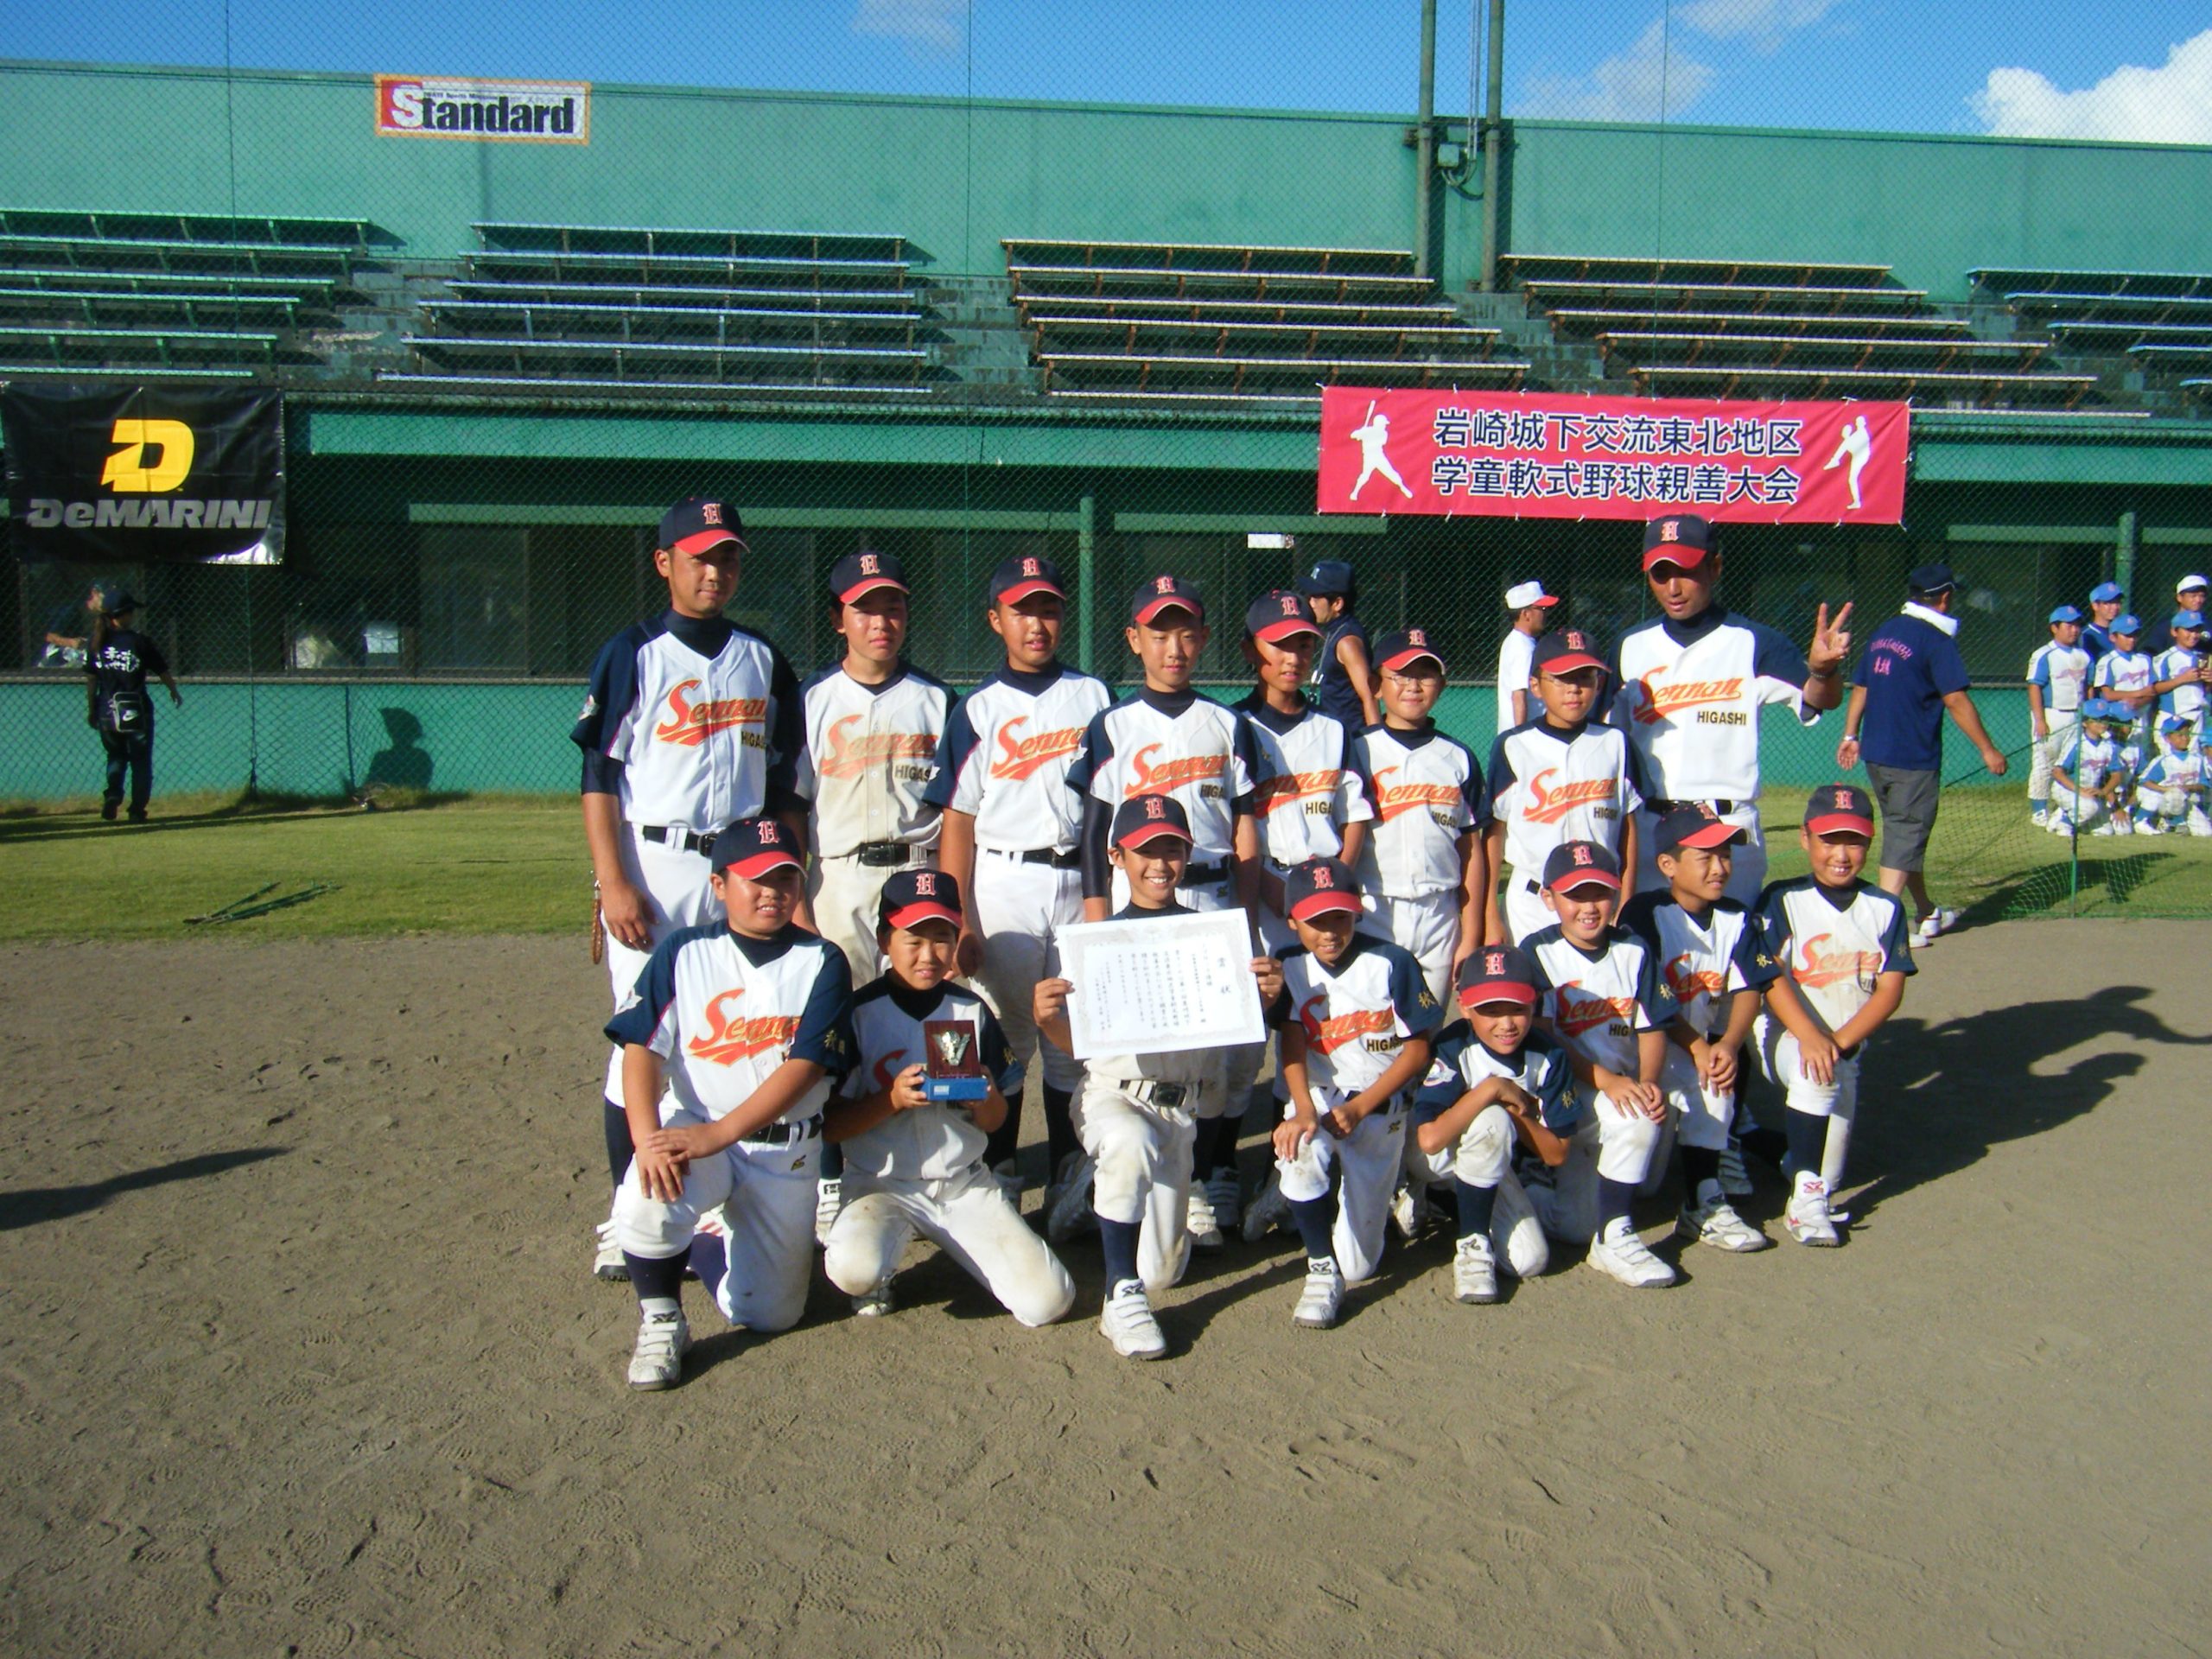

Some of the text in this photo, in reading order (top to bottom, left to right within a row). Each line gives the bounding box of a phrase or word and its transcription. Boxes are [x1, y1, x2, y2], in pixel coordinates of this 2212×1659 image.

[391, 84, 575, 134] Standard
[1434, 407, 1802, 456] 岩崎城下交流東北地区
[1432, 455, 1800, 505] 学童軟式野球親善大会
[26, 499, 272, 528] DeMARINI
[1696, 711, 1747, 726] HIGASHI
